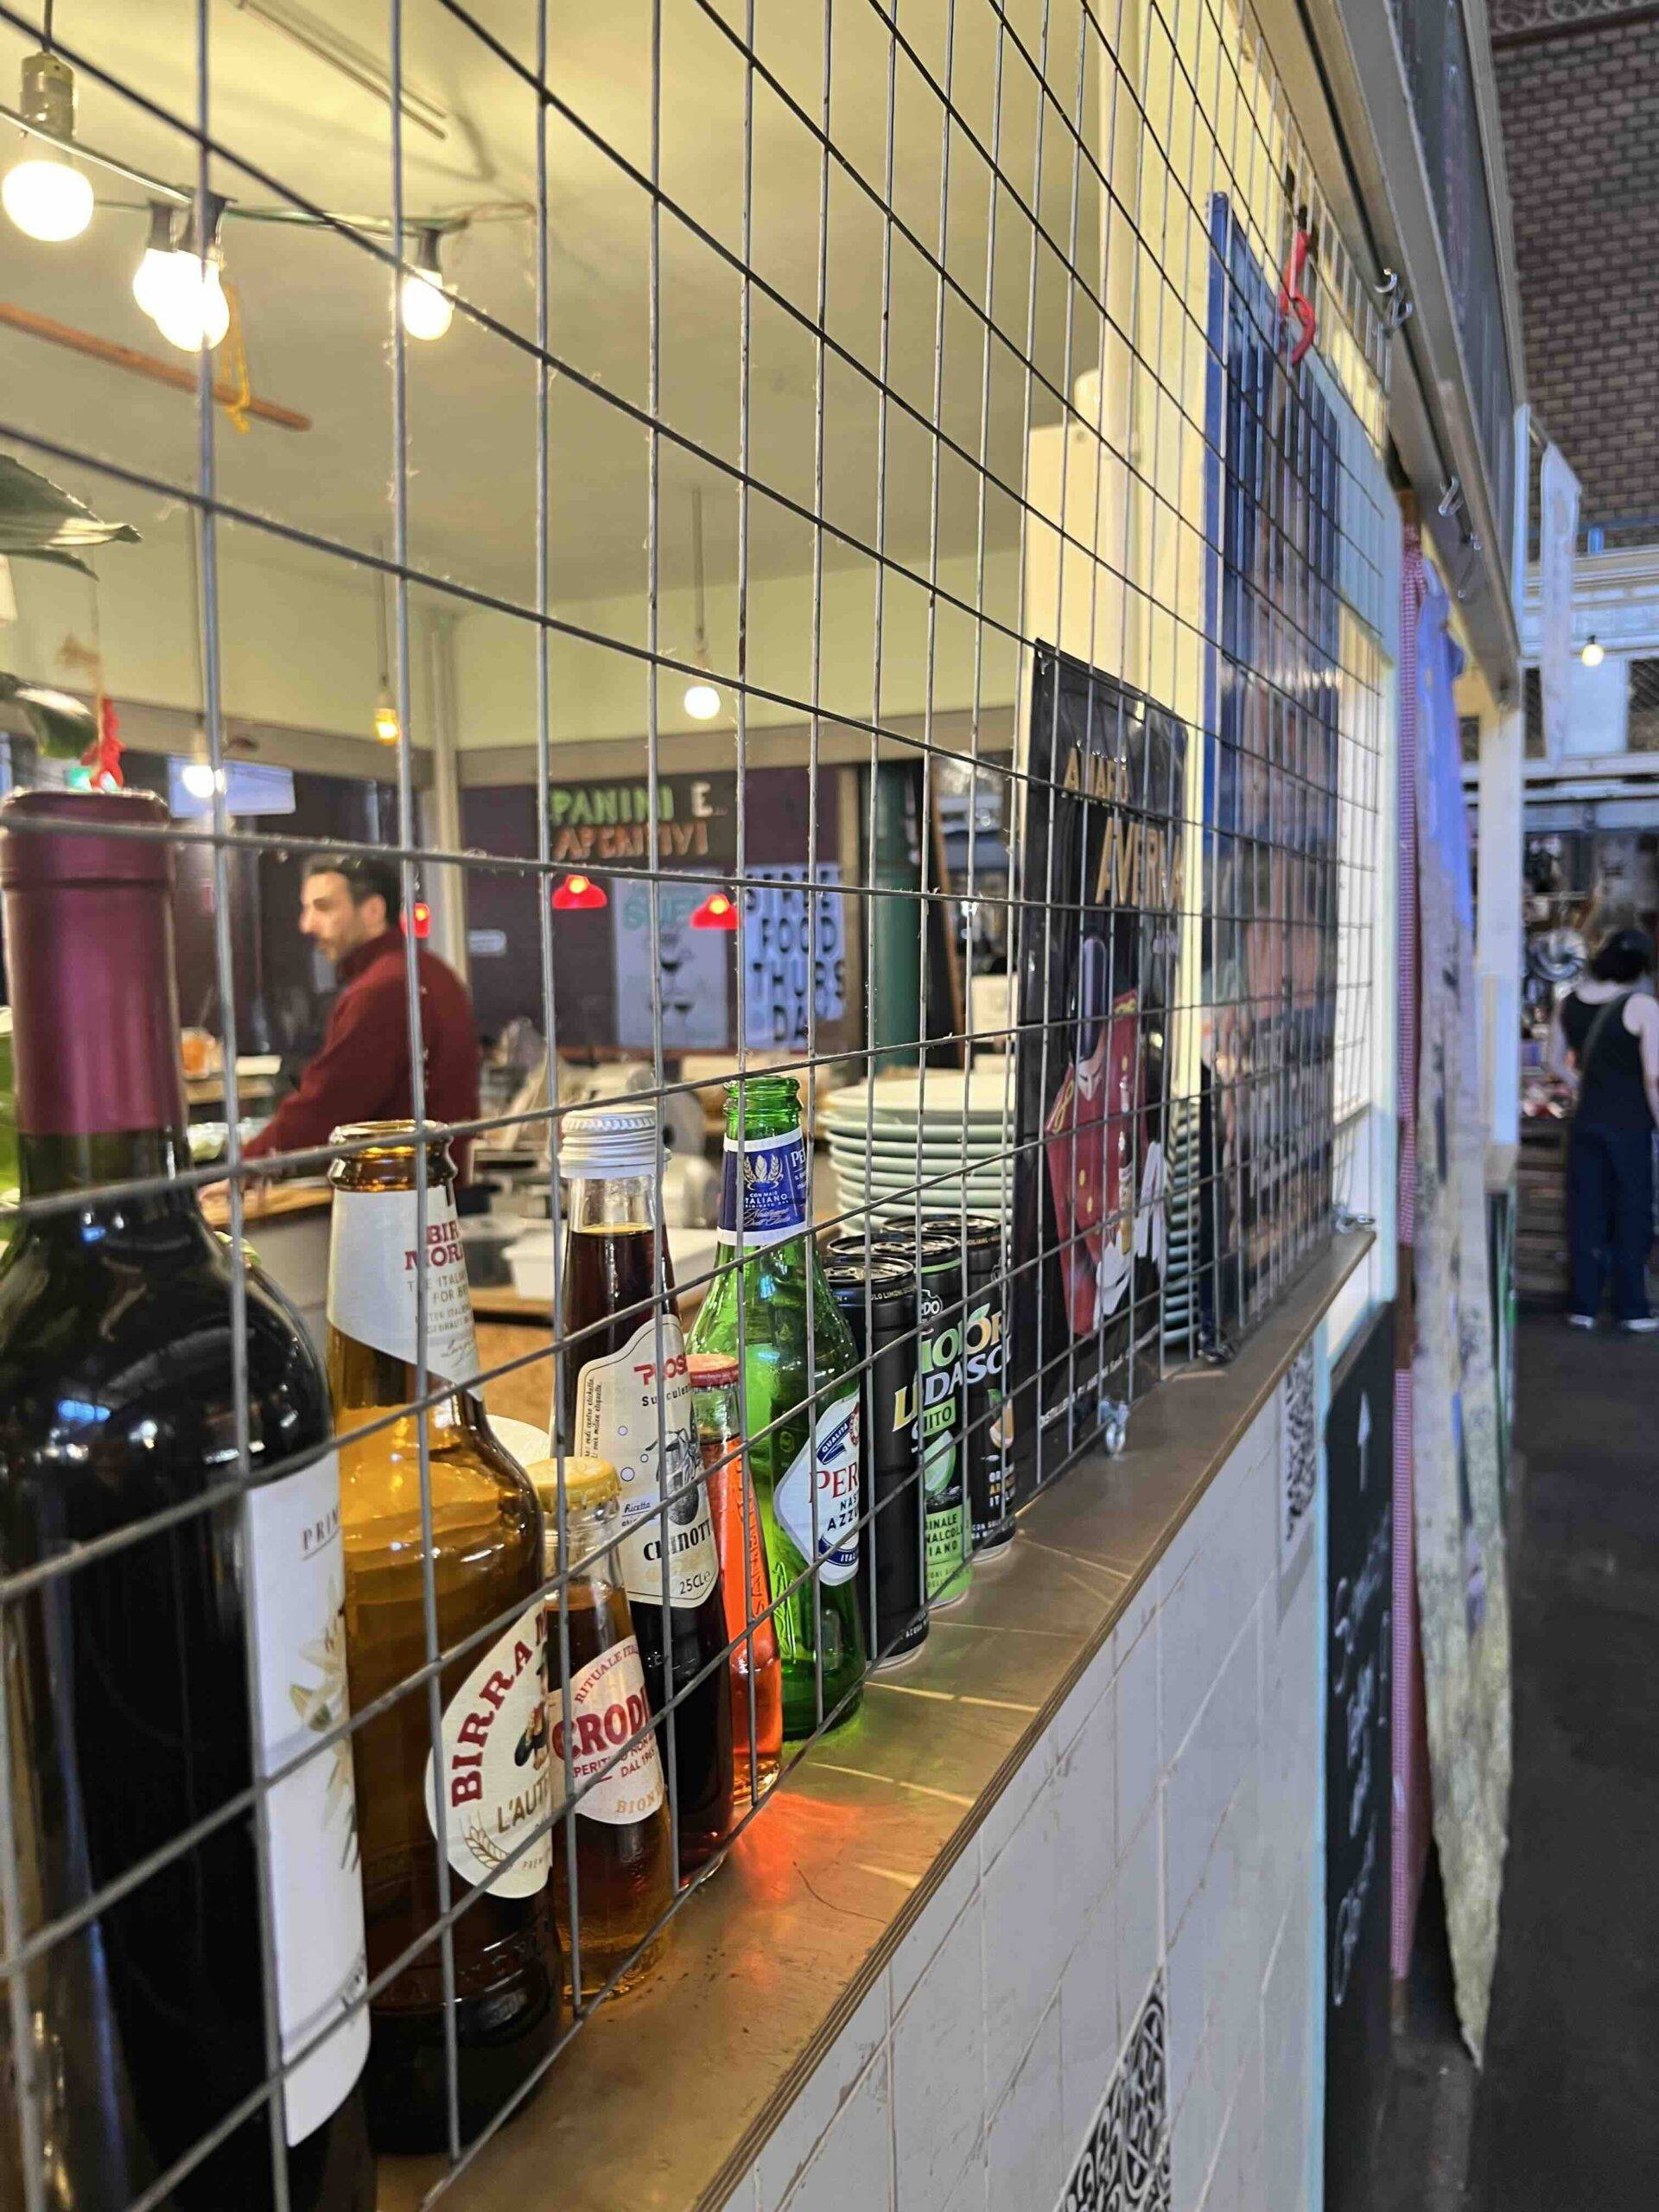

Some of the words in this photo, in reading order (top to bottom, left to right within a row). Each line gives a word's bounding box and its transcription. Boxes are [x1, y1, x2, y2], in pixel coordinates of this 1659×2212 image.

[761, 917, 837, 953] FOOD
[744, 1193, 787, 1205] TALIANO
[404, 1243, 464, 1270] MOR
[924, 1406, 952, 1433] JITO
[926, 1513, 957, 1530] INALE
[575, 1650, 621, 1705] RITUALE
[450, 1640, 533, 1808] BIRRA
[621, 1760, 641, 1777] DAL
